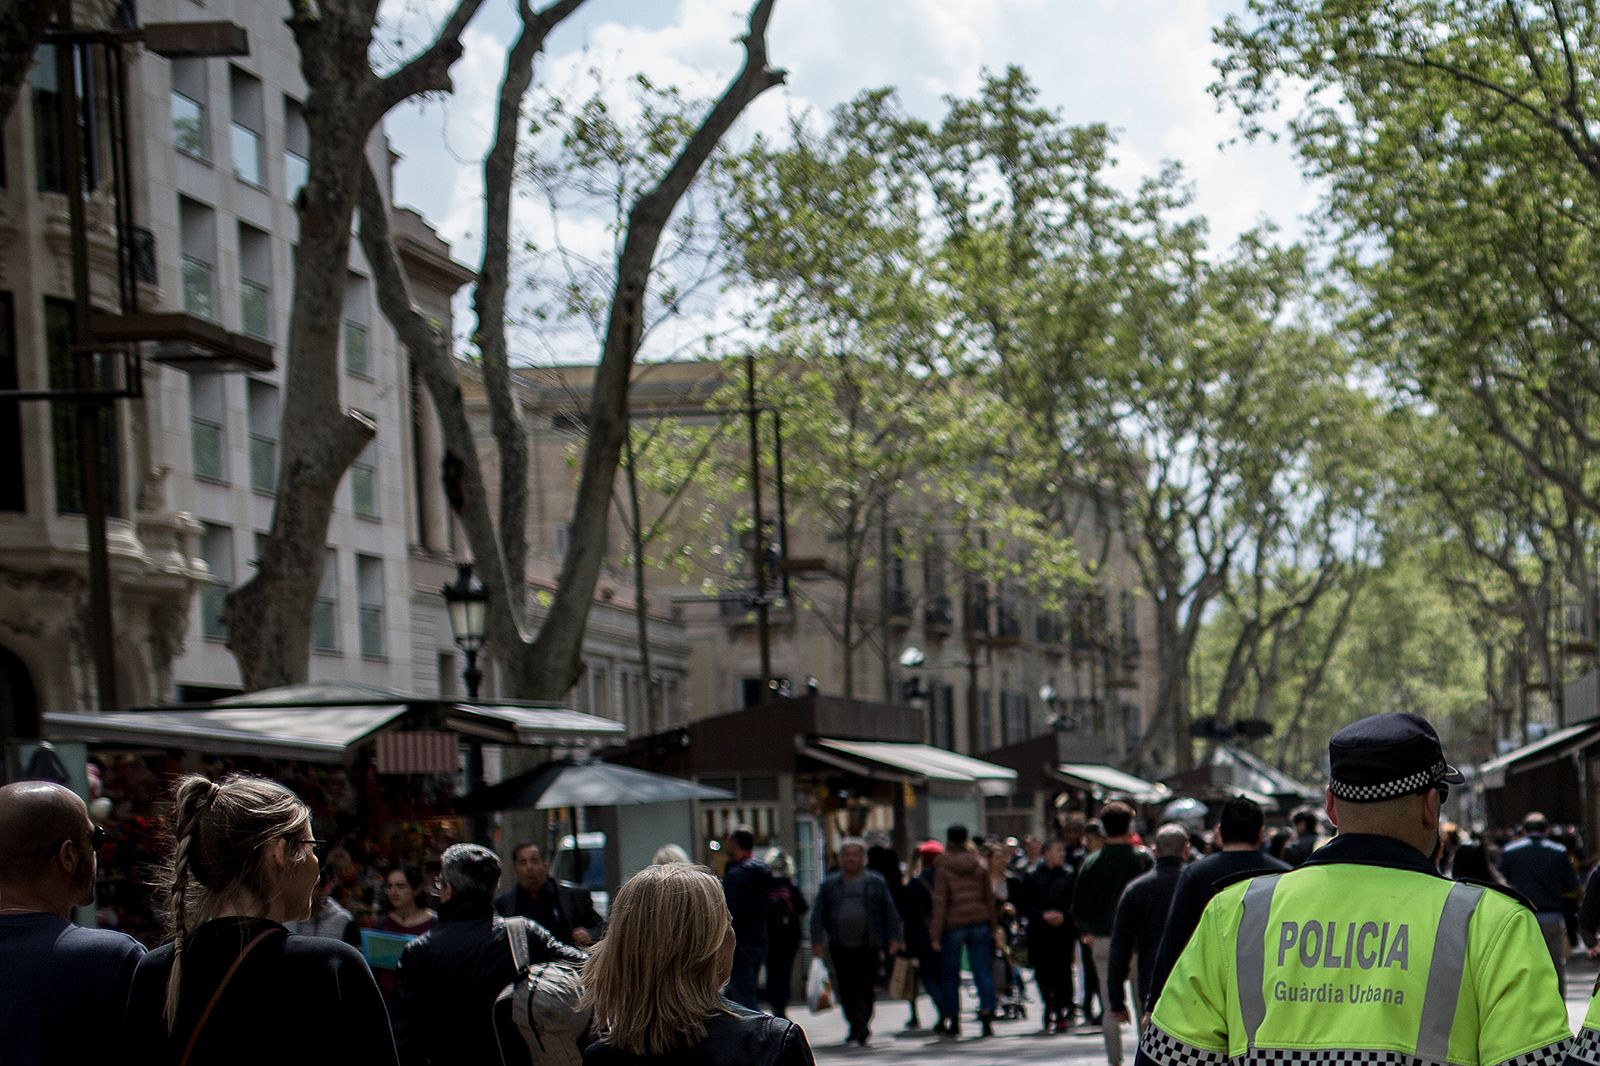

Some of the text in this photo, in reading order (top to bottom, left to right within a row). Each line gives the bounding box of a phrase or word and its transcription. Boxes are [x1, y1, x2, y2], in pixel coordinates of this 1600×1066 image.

[1277, 919, 1408, 971] POLICIA
[1274, 980, 1404, 1006] Guàrdia Urbana
